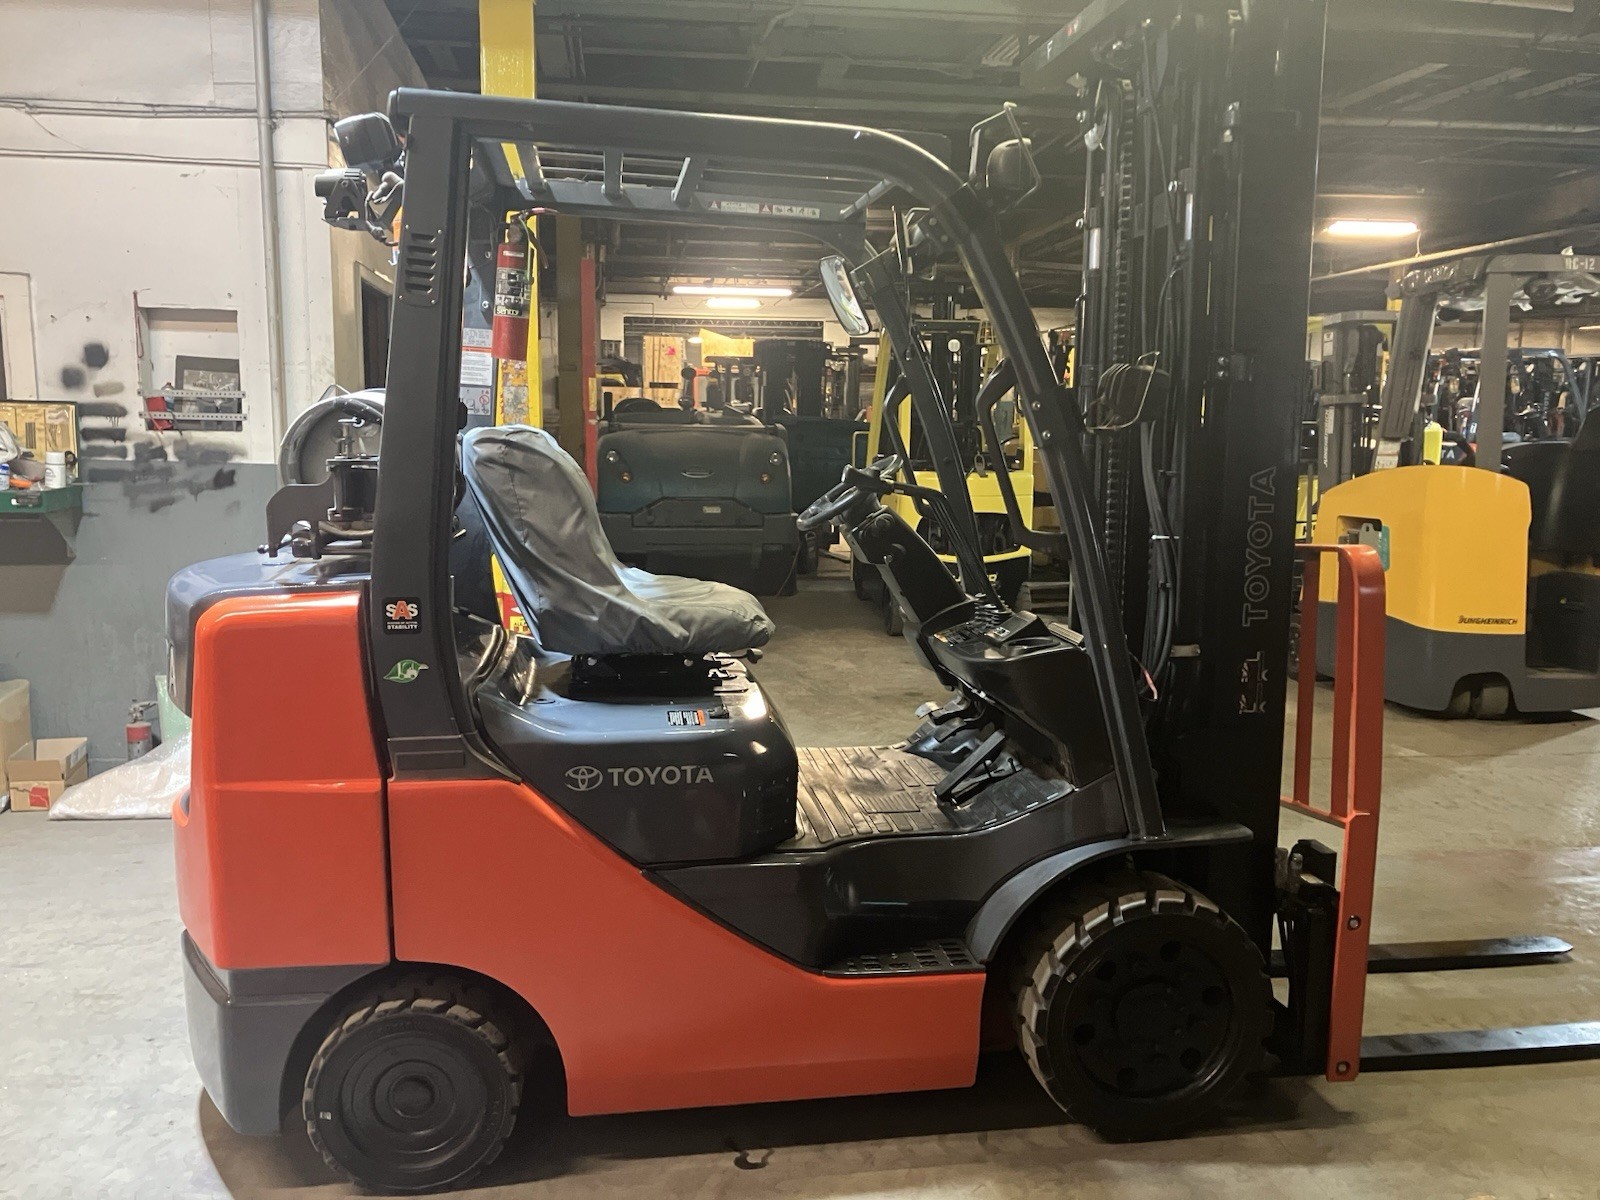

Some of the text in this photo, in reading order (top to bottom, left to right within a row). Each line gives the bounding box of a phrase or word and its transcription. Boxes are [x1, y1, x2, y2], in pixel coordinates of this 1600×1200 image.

[1242, 466, 1277, 627] TOYOTA
[385, 600, 419, 620] SAS
[1458, 615, 1518, 625] JUNGHEINRICH
[607, 765, 715, 787] TOYOTA
